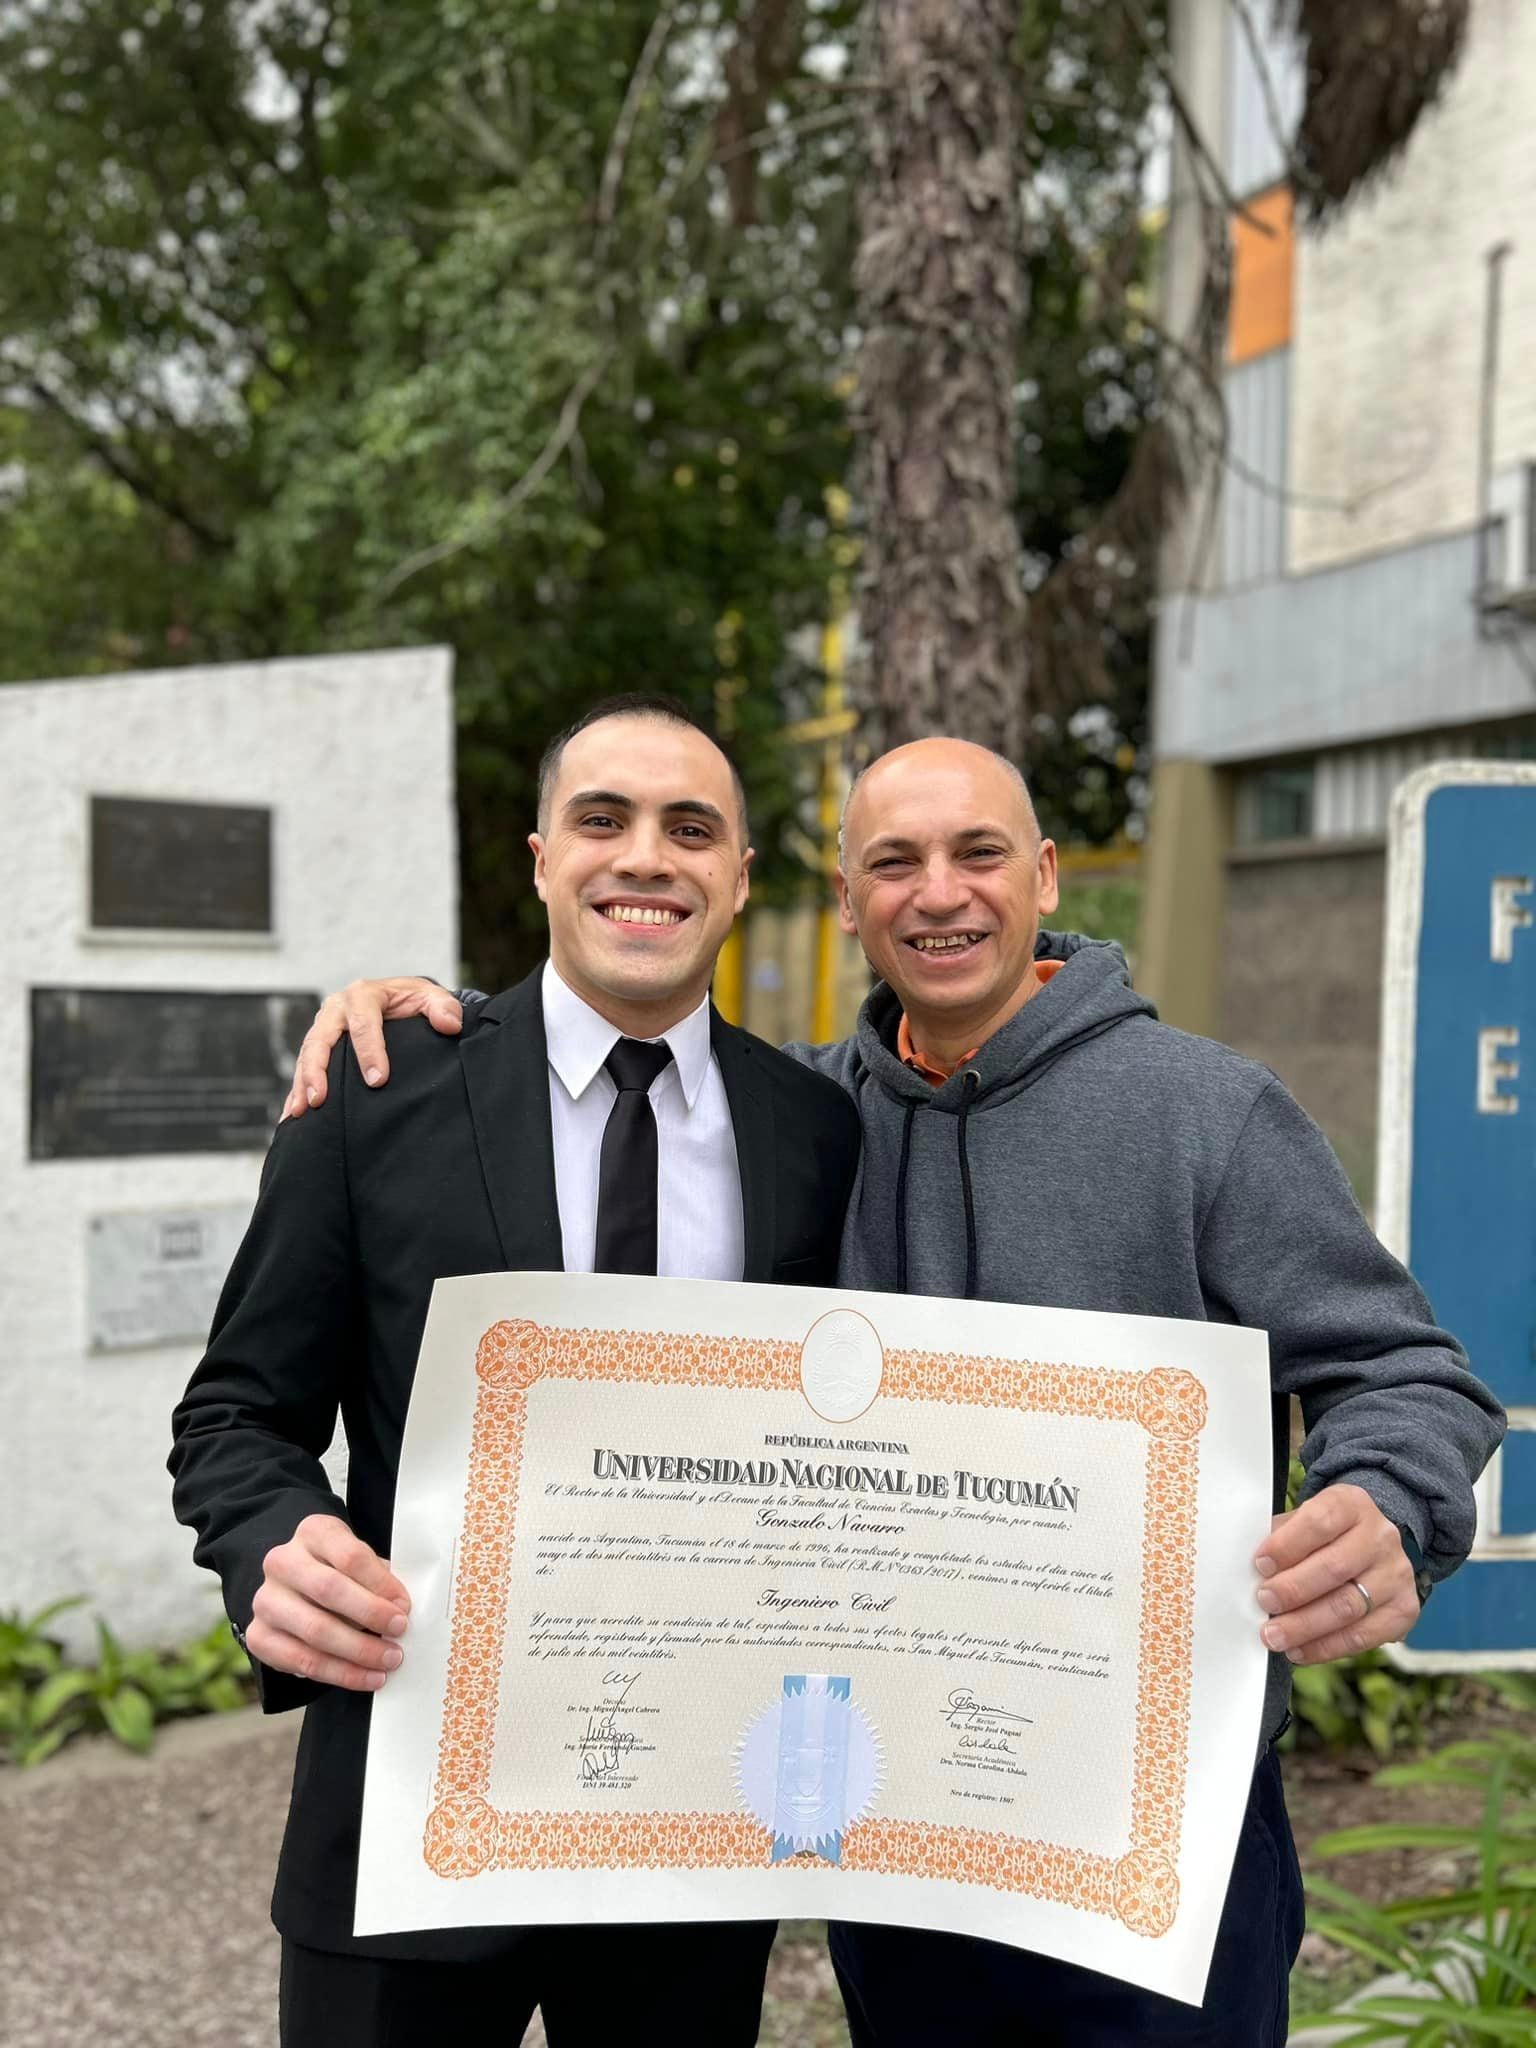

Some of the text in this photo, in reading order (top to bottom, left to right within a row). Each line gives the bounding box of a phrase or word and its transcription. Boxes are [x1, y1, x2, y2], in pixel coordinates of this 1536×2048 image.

[764, 1434, 911, 1454] REPÚBLICA ARGENTINA
[592, 1449, 1080, 1513] UNIVERSIDAD NACIONAL DE TUCUMÁN
[544, 1483, 561, 1496] El
[564, 1484, 598, 1497] Rector
[601, 1486, 614, 1497] de
[616, 1488, 628, 1499] la
[632, 1487, 694, 1502] Universidad
[696, 1495, 706, 1505] y
[709, 1492, 720, 1503] el
[719, 1492, 759, 1505] Decano
[762, 1495, 775, 1505] de
[777, 1495, 788, 1506] la
[789, 1495, 837, 1509] Facultad
[838, 1499, 850, 1510] de
[854, 1498, 896, 1512] Ciencias
[900, 1502, 939, 1516] Exactas
[939, 1510, 949, 1520] y
[1009, 1517, 1029, 1528] por
[756, 1508, 905, 1534] Gonzalo Navarro
[535, 1565, 554, 1576] de:
[536, 1550, 568, 1561] mayo
[570, 1549, 583, 1559] de
[585, 1549, 603, 1560] dos
[604, 1550, 622, 1561] mil
[674, 1555, 688, 1563] en
[690, 1553, 701, 1563] la
[703, 1556, 742, 1565] carrera
[743, 1555, 757, 1566] de
[820, 1556, 845, 1569] Civil
[968, 1573, 1008, 1585] venimos
[1011, 1578, 1019, 1586] a
[1022, 1577, 1070, 1593] conferirle
[1073, 1584, 1085, 1595] el
[538, 1532, 575, 1543] nacido
[577, 1535, 591, 1543] en
[654, 1534, 706, 1548] Tucumán
[709, 1537, 721, 1548] el
[737, 1539, 751, 1550] de
[752, 1542, 785, 1551] marzo
[788, 1541, 801, 1551] de
[834, 1542, 849, 1553] ha
[851, 1546, 901, 1558] realizado
[902, 1551, 911, 1560] y
[913, 1552, 972, 1565] completado
[975, 1555, 989, 1566] los
[992, 1558, 1032, 1571] estudios
[1035, 1564, 1047, 1573] el
[1070, 1569, 1098, 1580] cinco
[1100, 1572, 1114, 1582] de
[757, 1589, 898, 1613] Ingeniero Civil
[527, 1647, 541, 1657] de
[542, 1646, 571, 1660] julio
[573, 1647, 586, 1657] de
[588, 1647, 605, 1657] dos
[607, 1647, 625, 1658] mil
[542, 1616, 572, 1627] para
[576, 1617, 596, 1628] que
[600, 1615, 643, 1626] acredite
[647, 1619, 660, 1627] su
[716, 1617, 730, 1629] de
[733, 1618, 753, 1631] tal,
[823, 1623, 849, 1634] todos
[853, 1627, 869, 1635] sus
[873, 1625, 907, 1640] efectos
[911, 1627, 948, 1642] legales
[952, 1633, 967, 1643] el
[961, 1637, 1010, 1649] presente
[1013, 1640, 1059, 1656] diploma
[1062, 1650, 1083, 1660] que
[593, 1631, 648, 1644] registrado
[648, 1636, 656, 1646] y
[656, 1632, 702, 1647] firmado
[700, 1637, 723, 1647] por
[724, 1633, 740, 1645] las
[743, 1636, 802, 1647] autoridades
[907, 1642, 932, 1656] San
[934, 1647, 977, 1660] Miguel
[975, 1651, 989, 1662] de
[990, 1652, 1043, 1670] Tucumán,
[1047, 1662, 1110, 1679] veinticuatro
